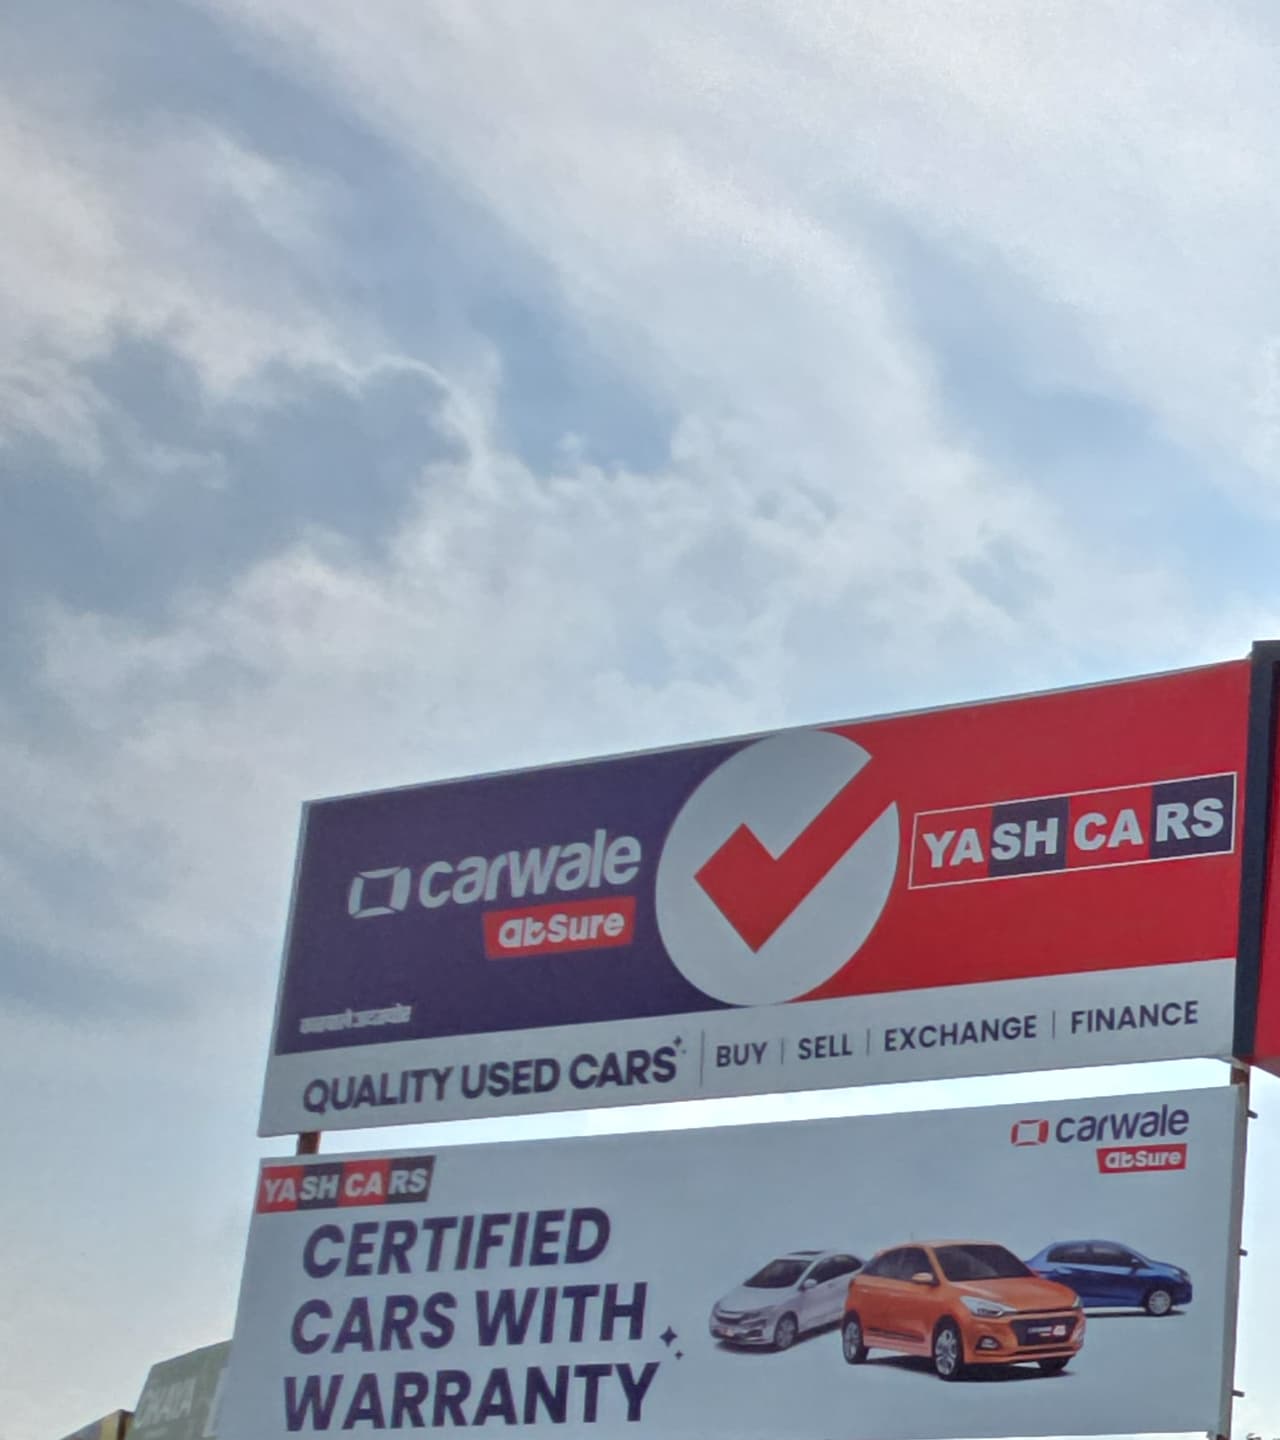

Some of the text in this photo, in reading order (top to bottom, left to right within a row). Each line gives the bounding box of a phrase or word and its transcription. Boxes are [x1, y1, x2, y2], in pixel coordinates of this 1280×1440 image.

[922, 798, 1225, 868] YASH CARS
[419, 829, 642, 909] carwale
[716, 1000, 1199, 1067] BUY SELL EXCHANGE FINANCE
[303, 1045, 678, 1114] QUALITY USED CARS
[1055, 1104, 1189, 1143] carwale
[263, 1167, 430, 1204] YASH CARS
[303, 1207, 611, 1279] CERTIFIED
[291, 1282, 648, 1355] CARS WITH
[283, 1362, 661, 1432] WARRANTY
